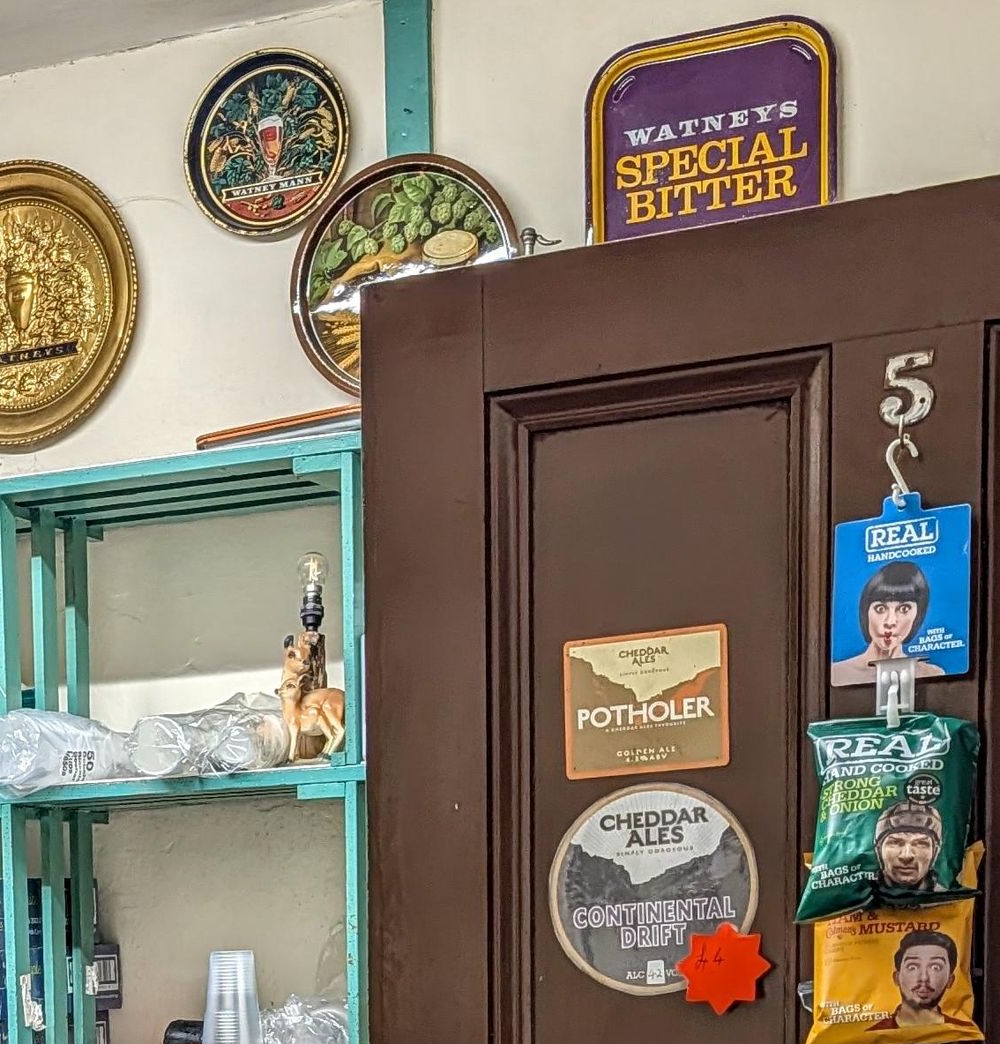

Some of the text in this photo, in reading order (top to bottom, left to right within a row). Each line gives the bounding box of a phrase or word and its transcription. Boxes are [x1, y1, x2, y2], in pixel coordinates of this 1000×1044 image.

[624, 99, 798, 146] WATNEYS
[615, 126, 808, 190] SPECIAL
[231, 174, 313, 198] WATNEY MANN
[625, 165, 798, 224] BITTER
[879, 349, 935, 426] 5
[869, 522, 935, 548] REAL
[868, 546, 936, 563] HANDCOOKED
[919, 633, 943, 644] BAGS
[927, 627, 945, 635] WITH
[619, 646, 669, 659] CHEDDAR
[632, 655, 656, 667] ALES
[577, 696, 715, 730] POTHOLER
[617, 745, 676, 757] GOLDEN ALE
[825, 733, 947, 763] REAL
[821, 785, 898, 812] CHEDDAR
[823, 776, 881, 799] STRONG
[906, 785, 941, 796] taste
[829, 797, 884, 816] ONION
[599, 807, 709, 832] CHEDDAR
[626, 826, 685, 848] ALES
[821, 865, 849, 880] BAGS
[573, 896, 736, 929] CONTINENTAL
[868, 911, 880, 921] &
[621, 922, 687, 949] DRIFT
[859, 921, 941, 936] MUSTARD
[626, 970, 646, 980] ALC
[831, 1003, 860, 1015] BAGS
